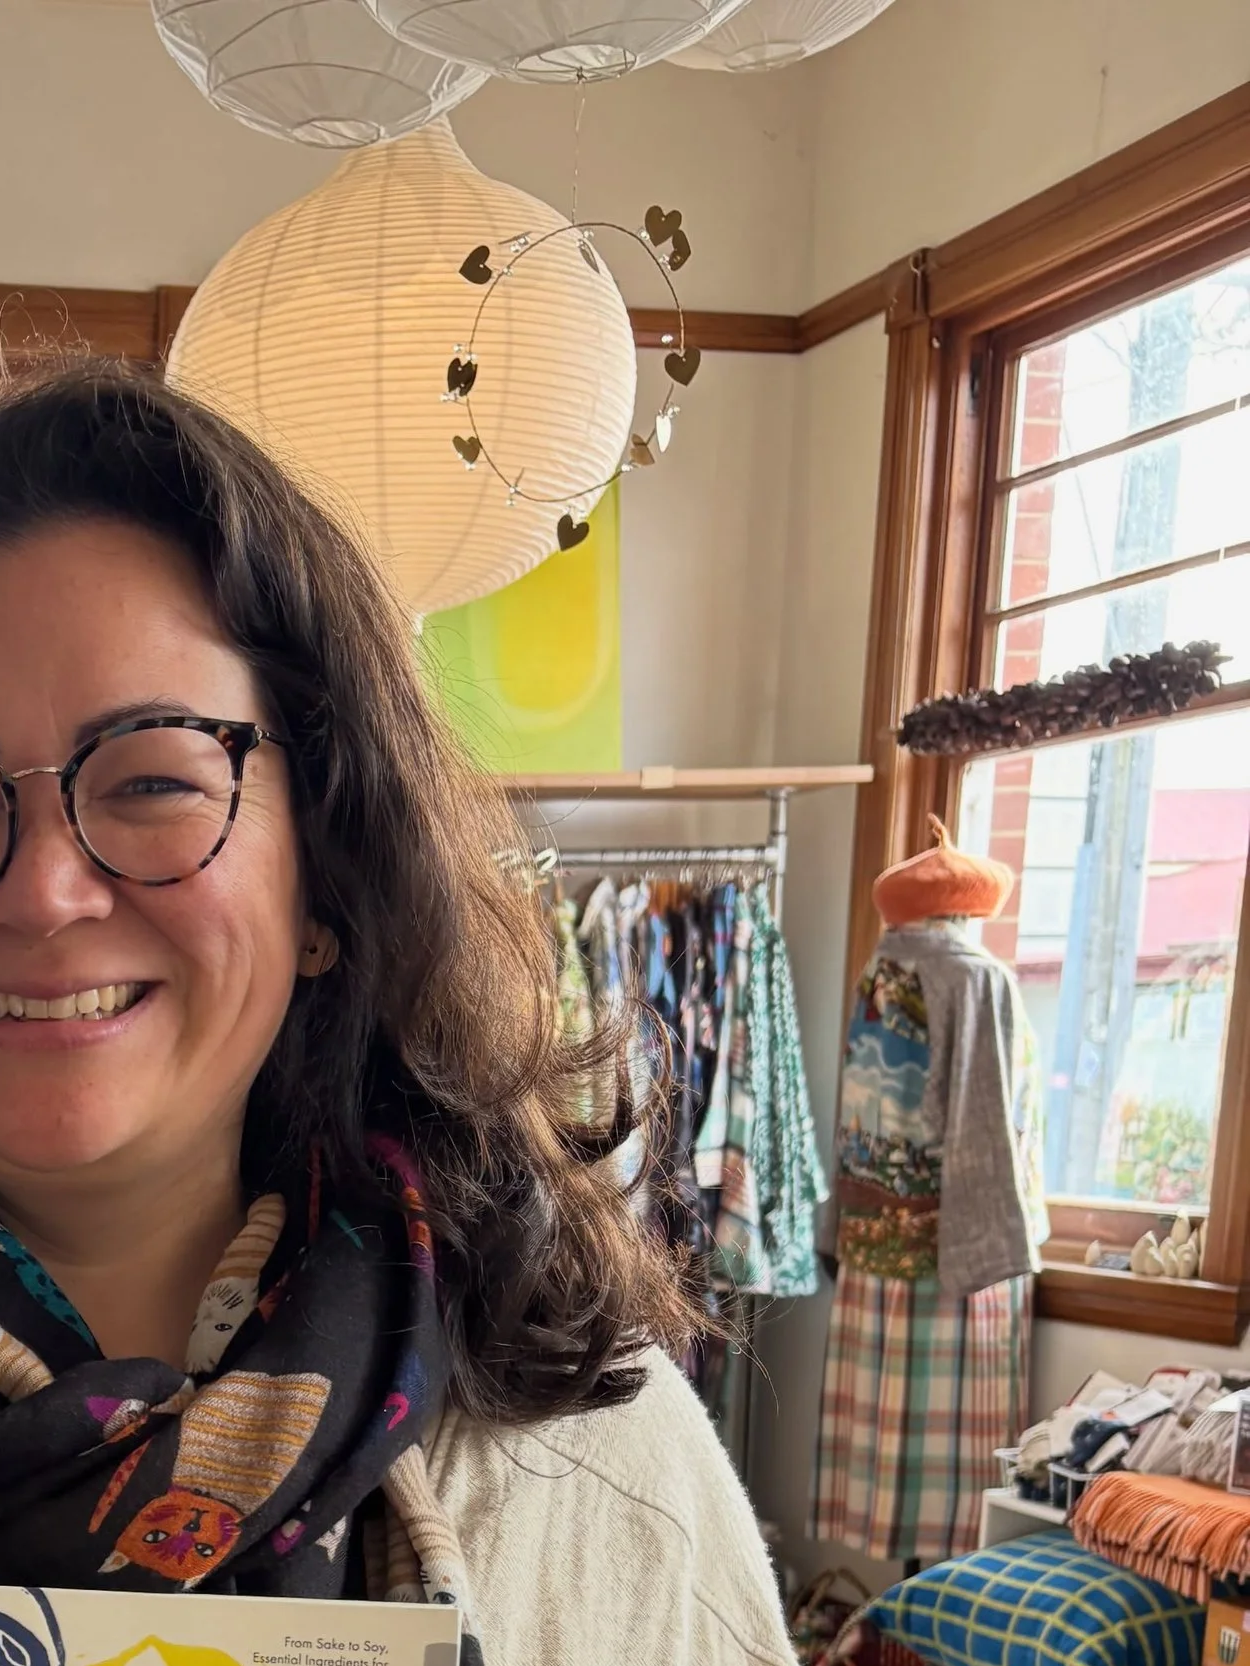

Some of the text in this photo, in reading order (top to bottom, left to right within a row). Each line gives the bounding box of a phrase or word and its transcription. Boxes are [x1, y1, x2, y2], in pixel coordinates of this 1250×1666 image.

[284, 1636, 389, 1656] From Sake to Soy,
[252, 1652, 301, 1665] Essential
